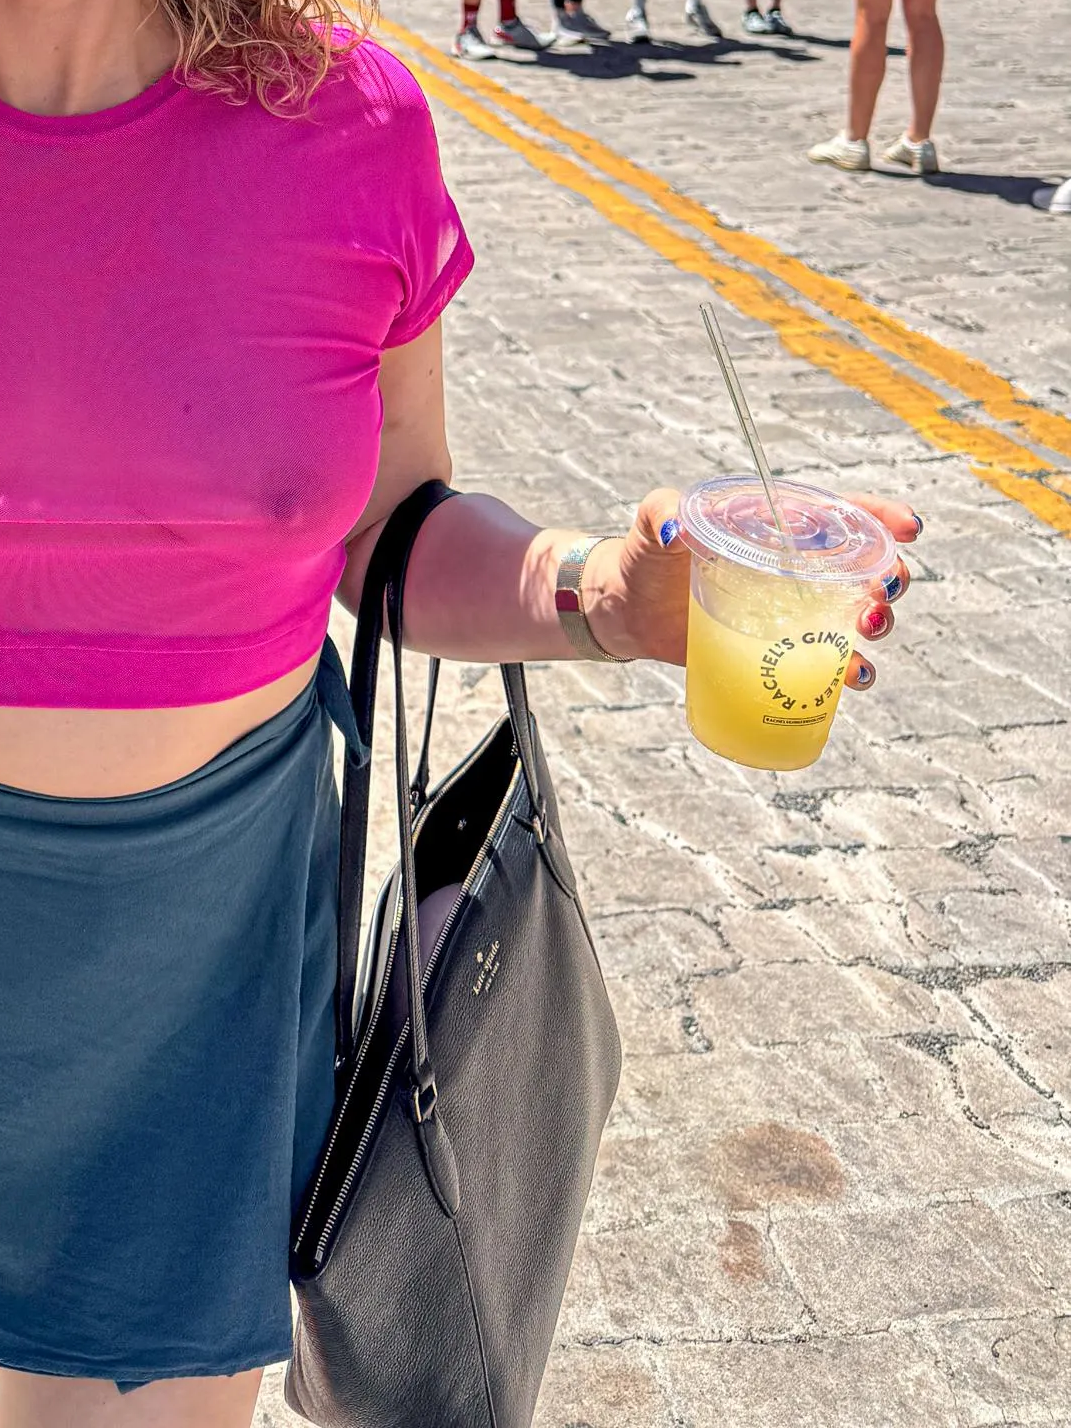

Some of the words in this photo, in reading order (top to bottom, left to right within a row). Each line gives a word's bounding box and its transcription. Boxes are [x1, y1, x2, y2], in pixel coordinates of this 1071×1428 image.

[801, 631, 850, 662] GINGER
[760, 637, 796, 710] RACHEL'S
[814, 666, 845, 707] BEER
[472, 971, 487, 997] kate
[484, 940, 500, 972] spade
